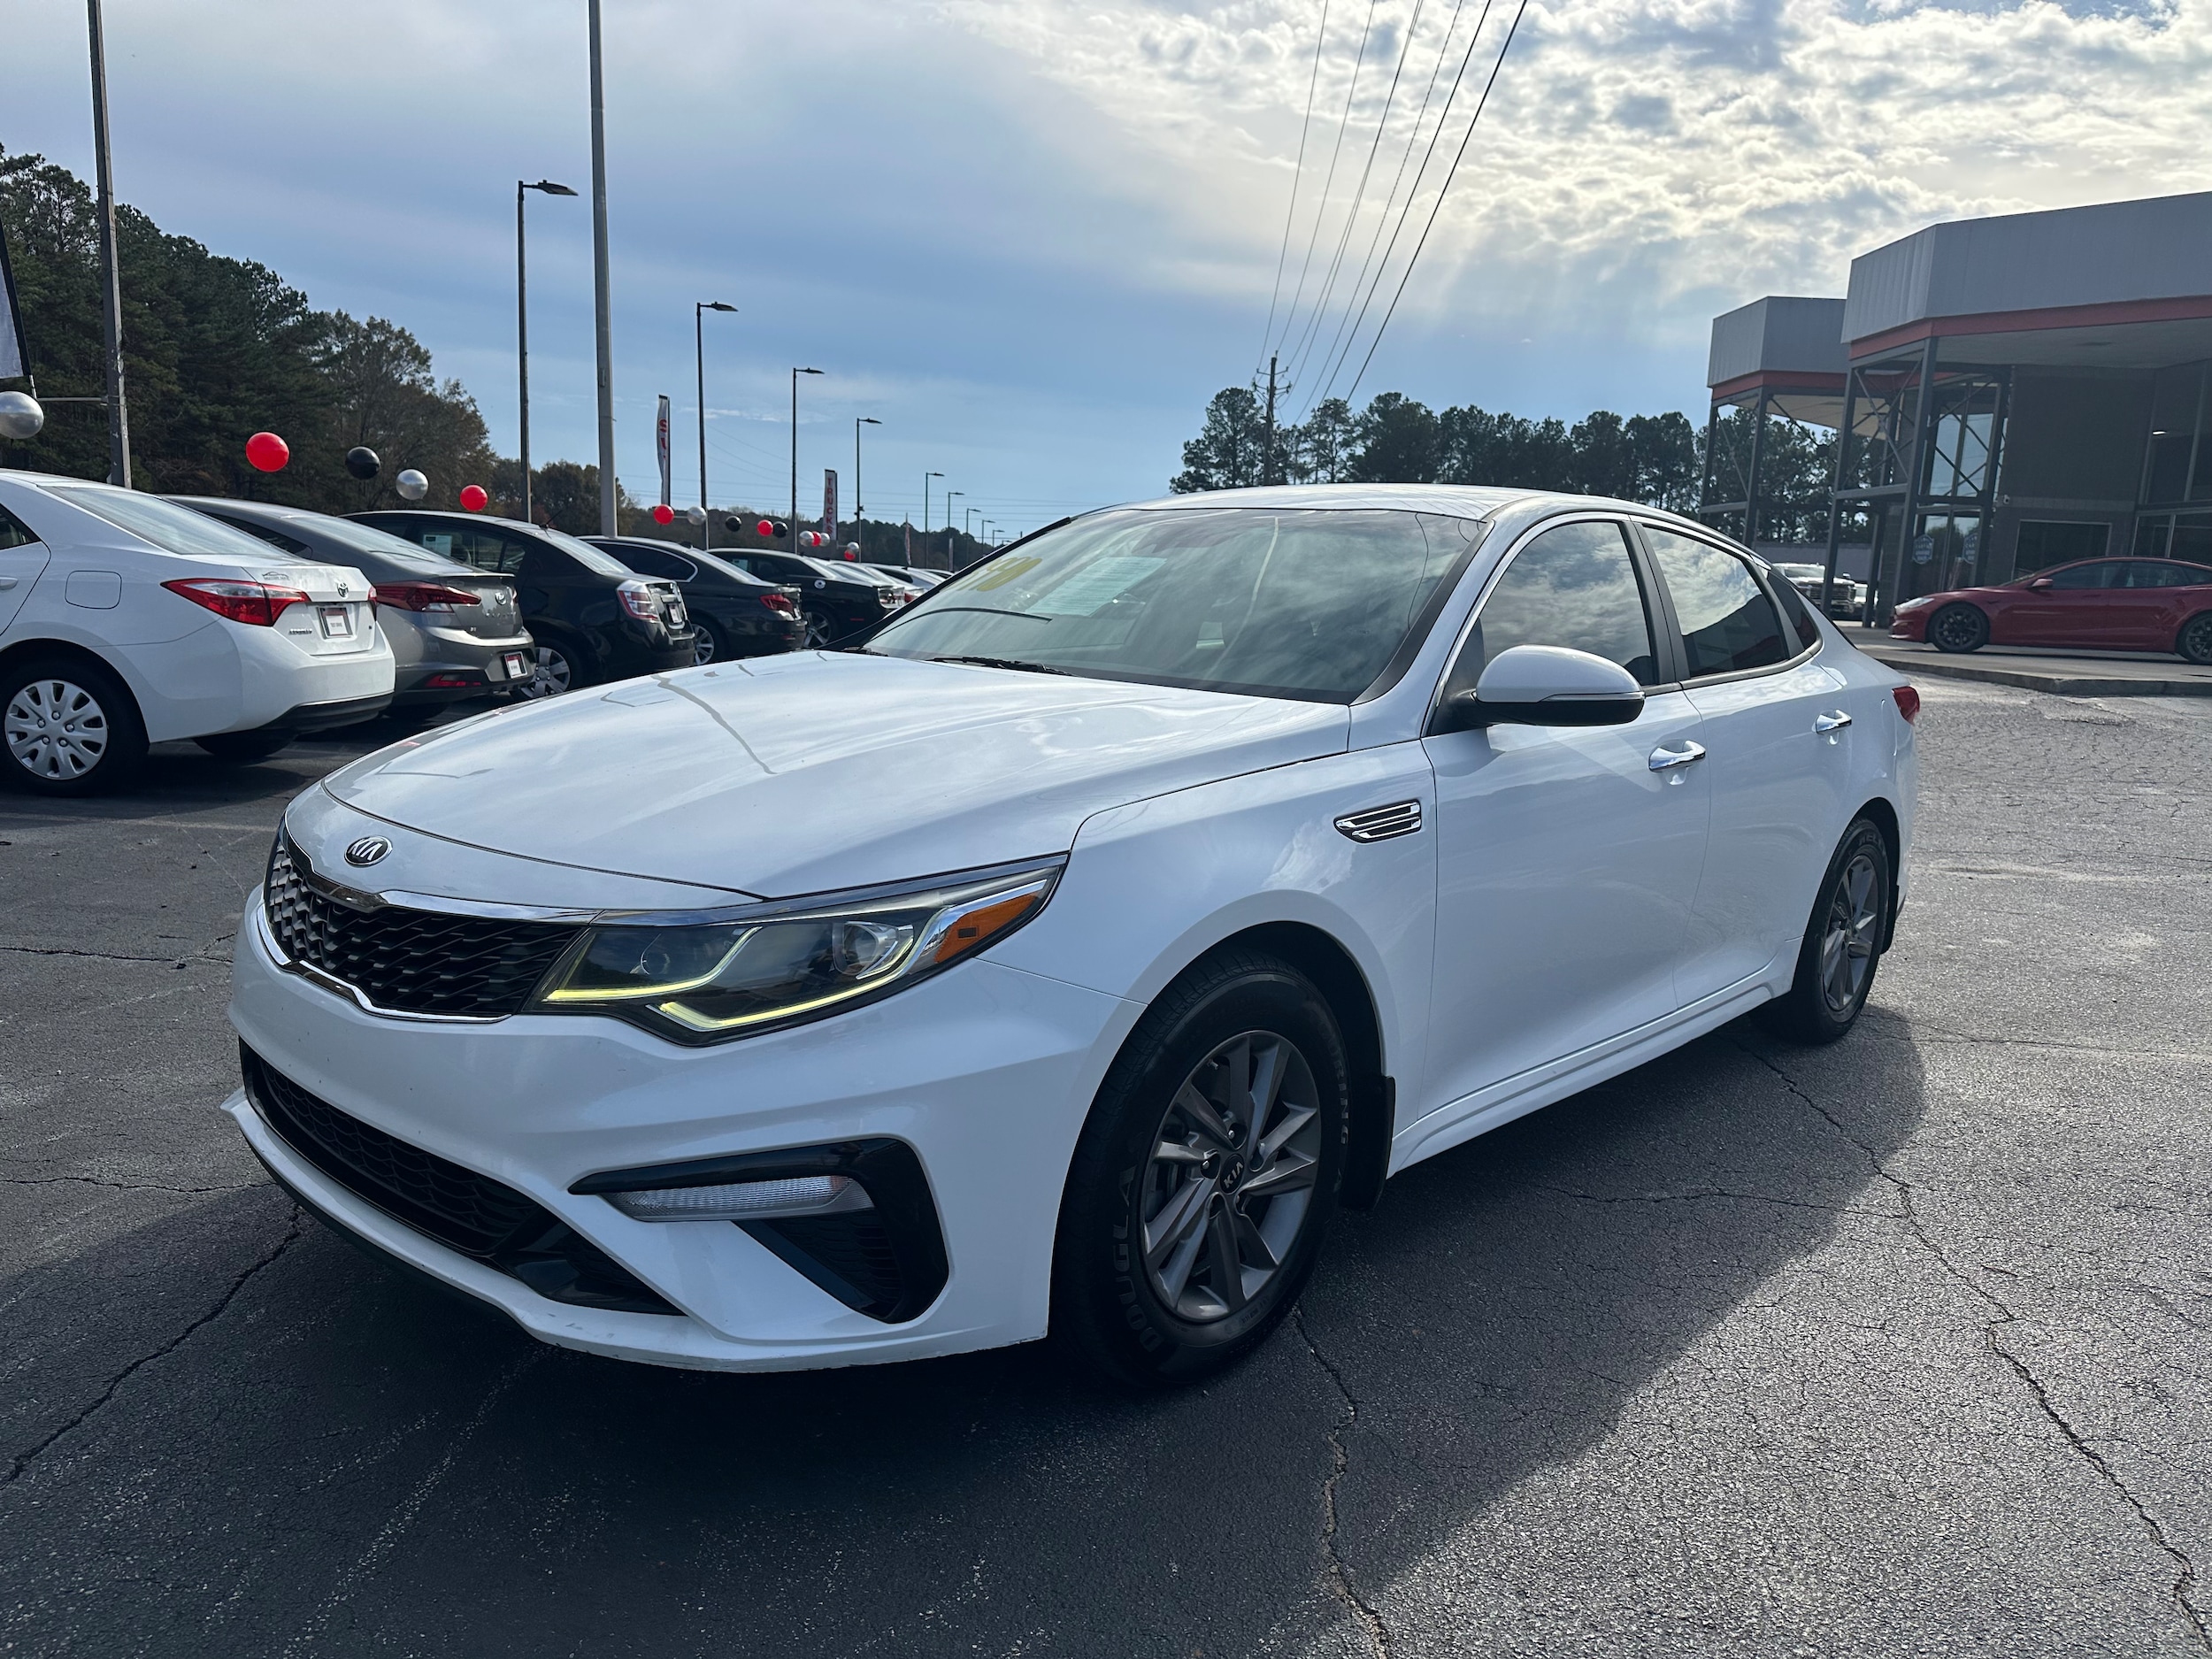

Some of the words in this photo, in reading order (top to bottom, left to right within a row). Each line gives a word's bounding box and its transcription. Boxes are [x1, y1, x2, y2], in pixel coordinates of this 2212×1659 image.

[826, 478, 834, 534] TRUCKS
[348, 839, 383, 862] KIA
[1224, 1161, 1244, 1189] KIA
